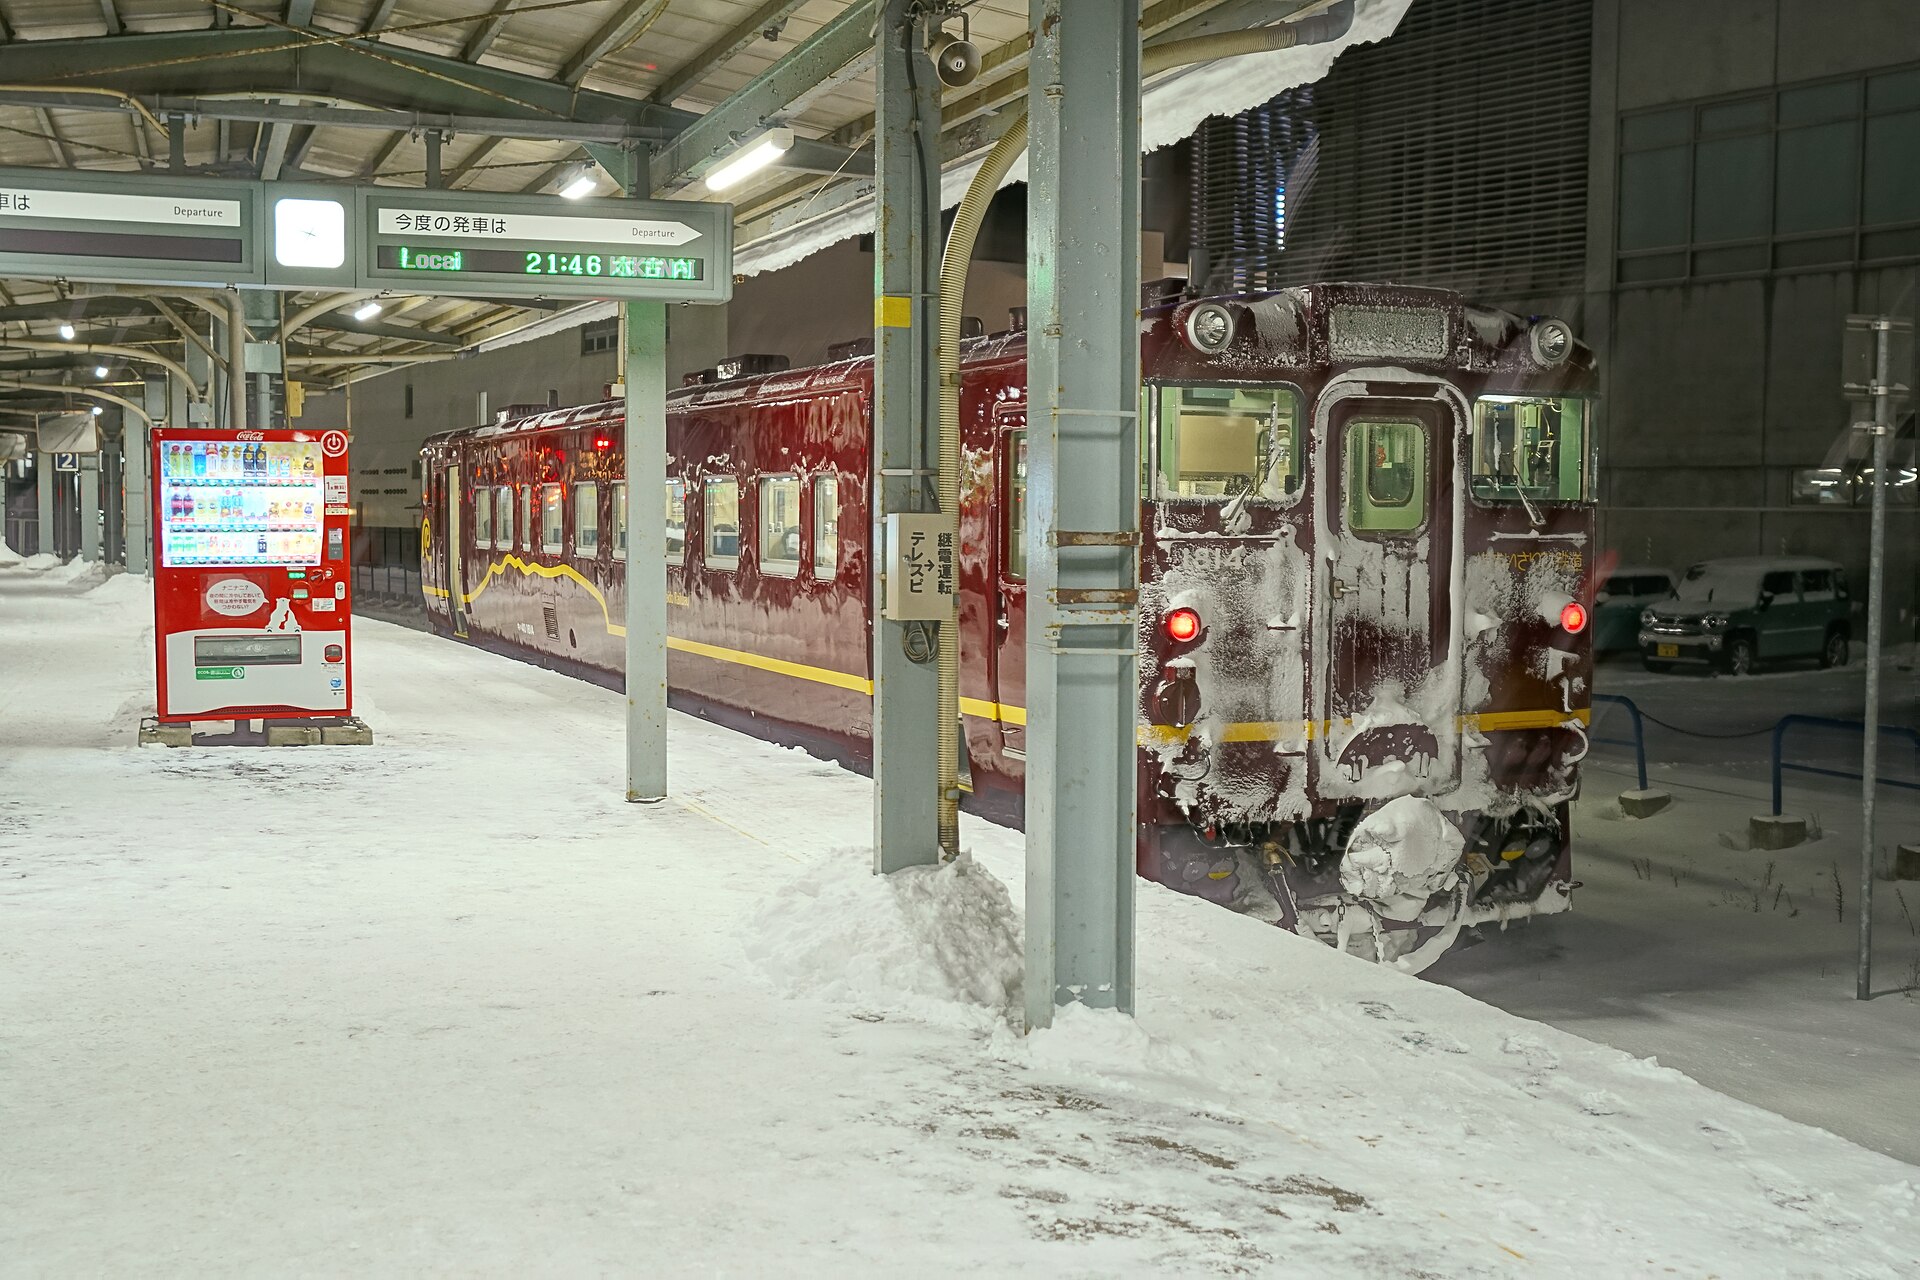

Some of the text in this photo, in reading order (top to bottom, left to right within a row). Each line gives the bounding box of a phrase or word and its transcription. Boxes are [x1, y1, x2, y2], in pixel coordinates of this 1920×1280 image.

[174, 205, 223, 218] Departure
[395, 213, 507, 234] 今度の発車は
[632, 227, 675, 239] Departure
[400, 247, 602, 276] Local 21:46
[61, 452, 74, 469] 2
[910, 531, 926, 594] テレスピ
[937, 532, 952, 595] 継電運転
